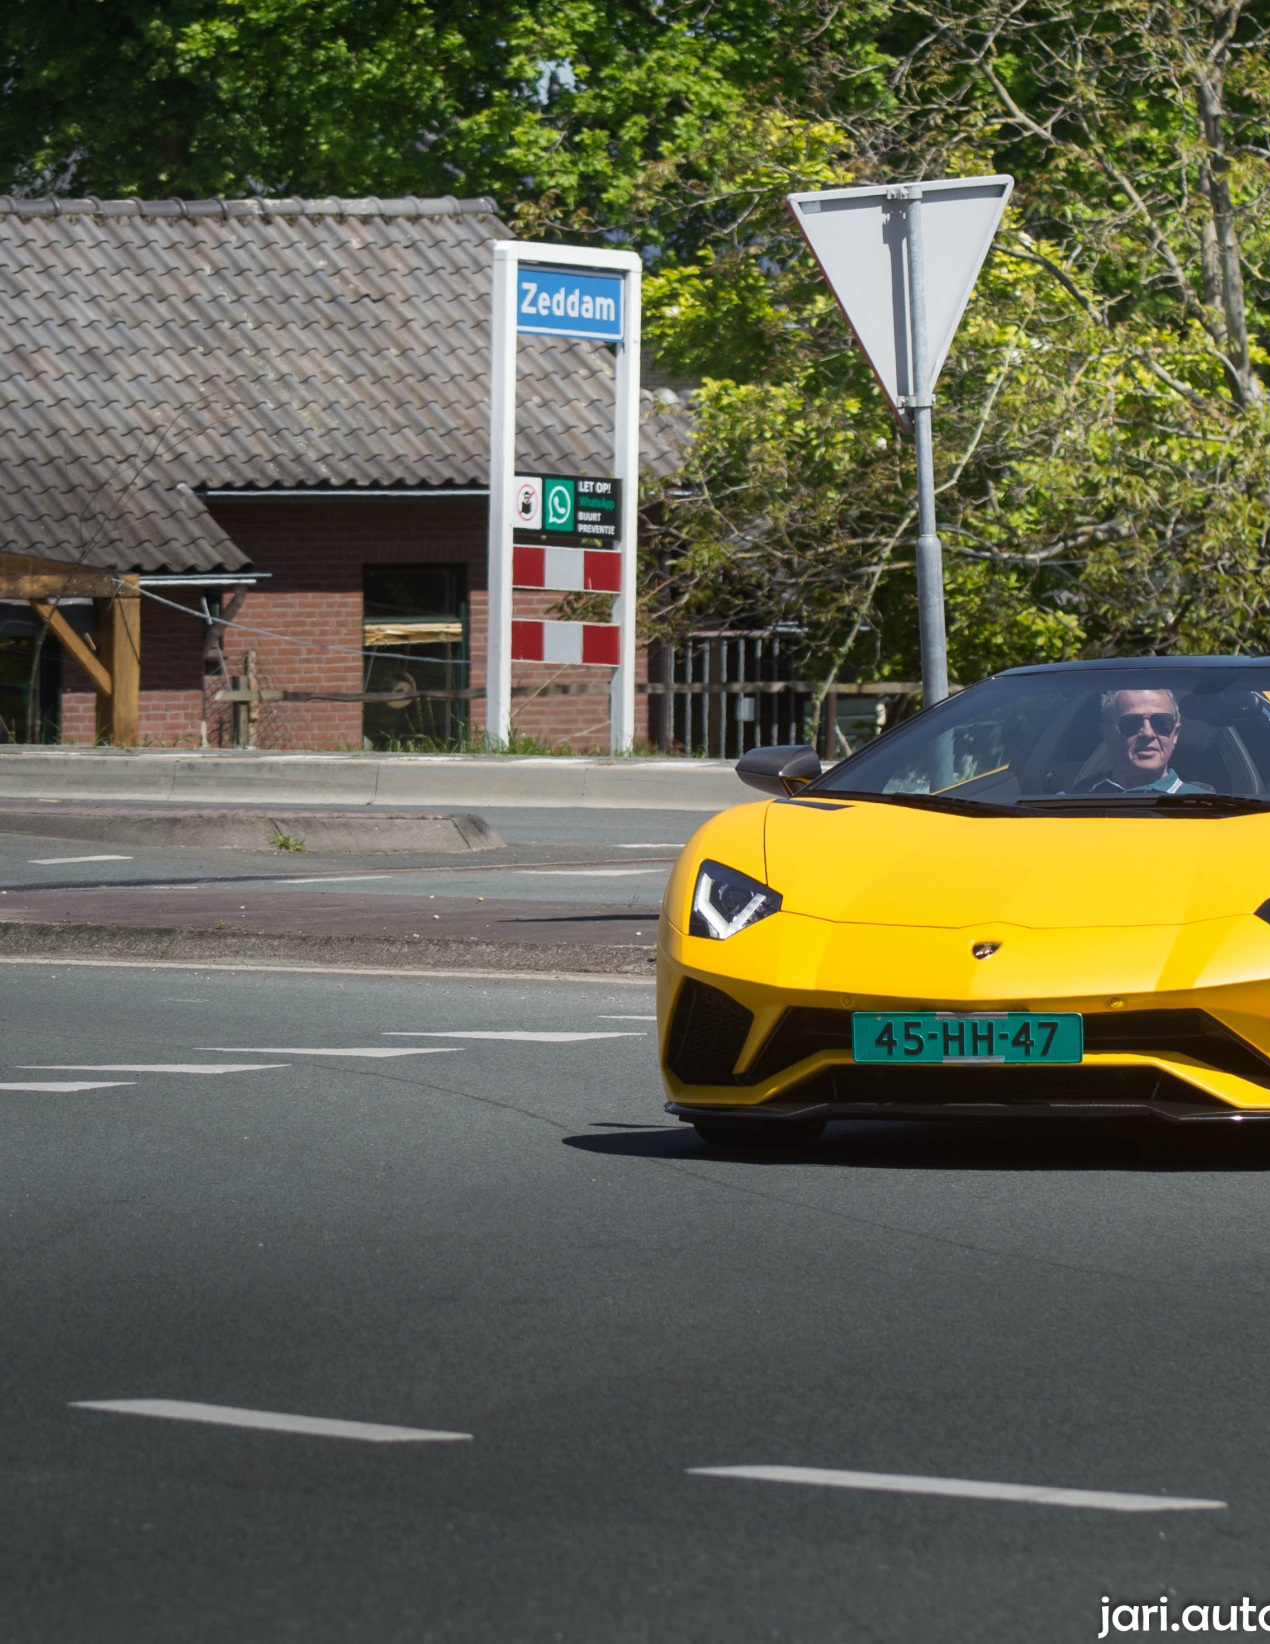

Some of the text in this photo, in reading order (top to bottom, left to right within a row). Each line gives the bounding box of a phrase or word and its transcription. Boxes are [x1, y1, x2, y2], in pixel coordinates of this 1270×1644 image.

[521, 282, 616, 321] Zeddam
[578, 481, 611, 494] LET OP!
[579, 496, 616, 511] WhatsApp
[578, 511, 602, 522] BUURT
[578, 523, 616, 535] PREVENTIE
[875, 1020, 1060, 1056] 45-HH-47
